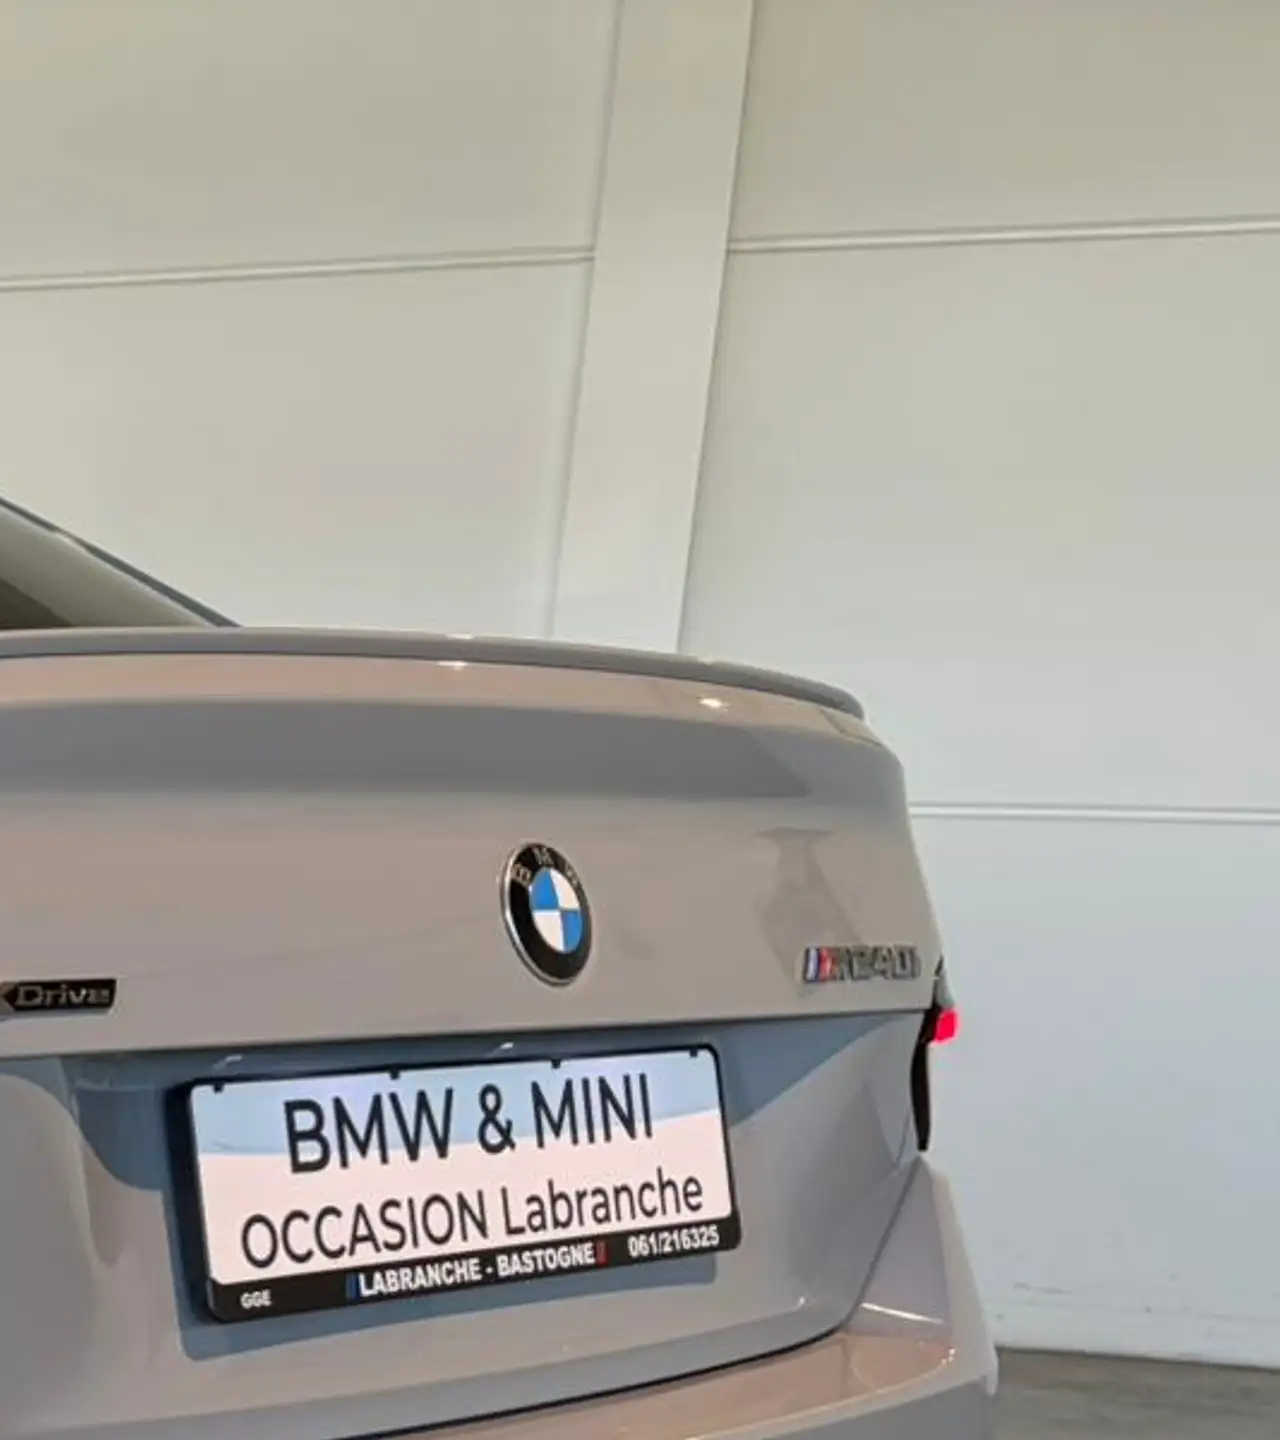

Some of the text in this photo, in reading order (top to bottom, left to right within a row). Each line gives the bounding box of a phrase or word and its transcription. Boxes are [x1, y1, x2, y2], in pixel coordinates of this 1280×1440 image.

[284, 1072, 653, 1174] BMW & MINI
[241, 1165, 704, 1269] OCCASION Labranche
[358, 1257, 482, 1298] LABRANCHE
[496, 1242, 596, 1278] BASTOGNE
[627, 1225, 720, 1258] 061/216325
